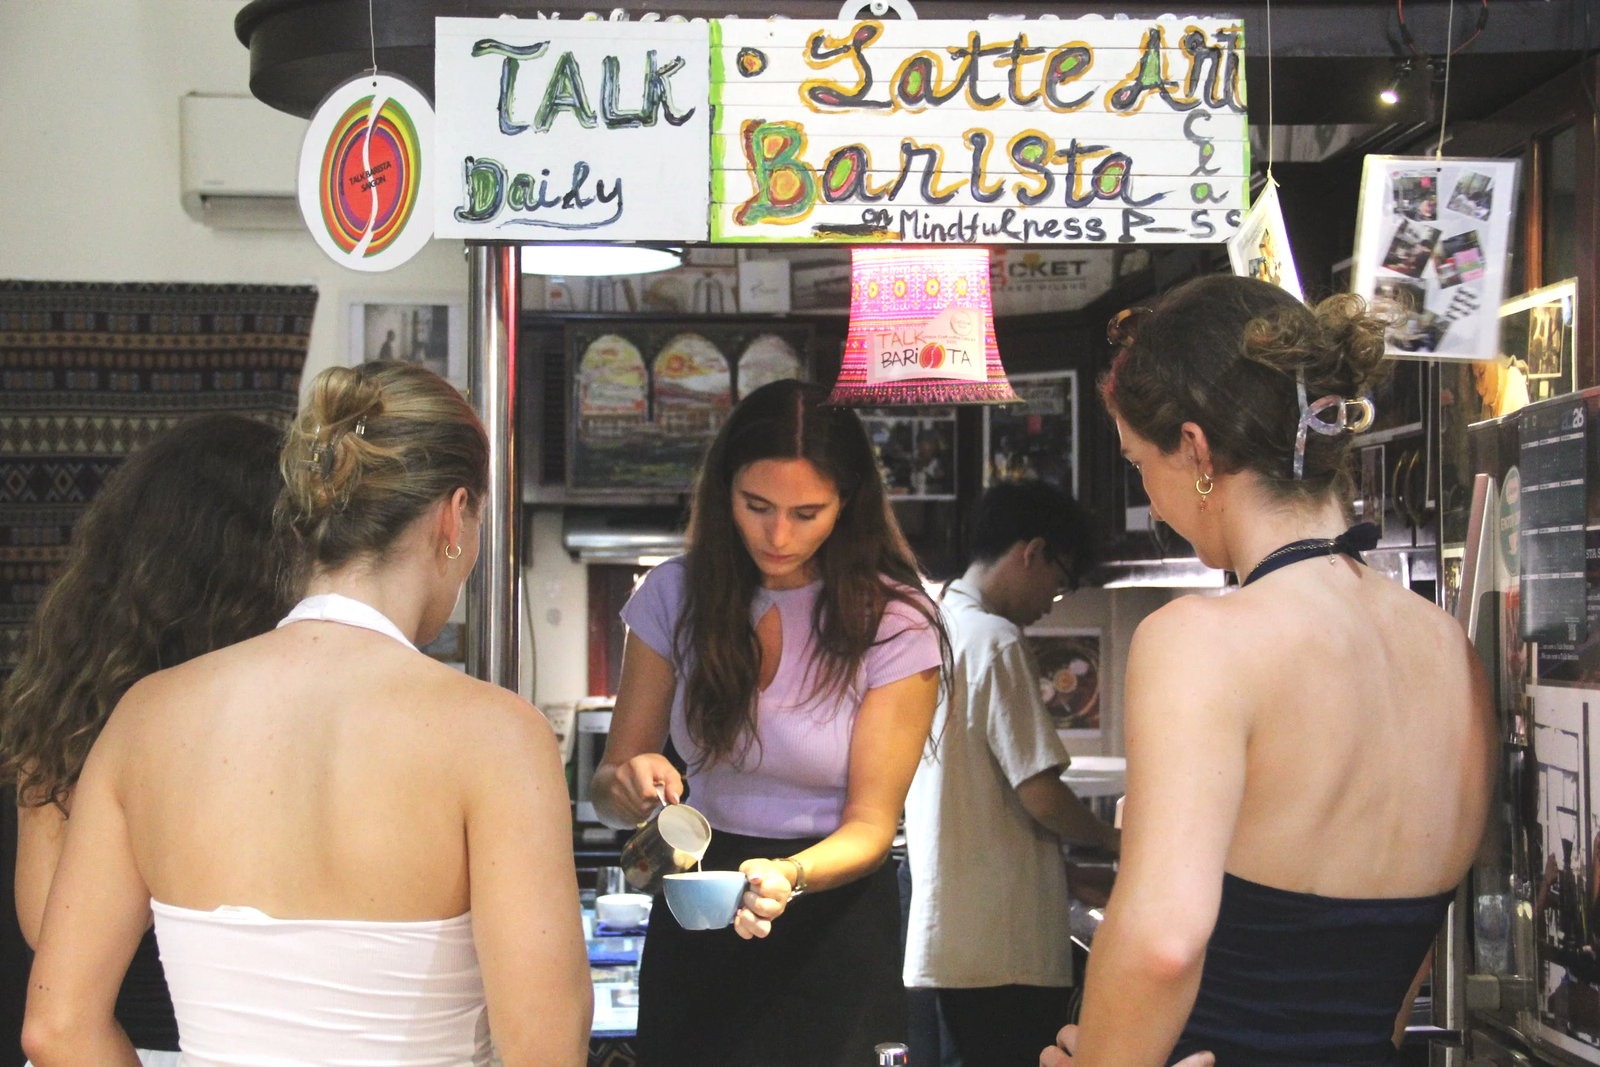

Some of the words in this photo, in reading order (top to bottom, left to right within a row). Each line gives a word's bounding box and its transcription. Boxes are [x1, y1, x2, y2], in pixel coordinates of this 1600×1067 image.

[798, 20, 1101, 115] Latte
[1104, 24, 1248, 117] Art
[471, 39, 697, 136] TALK
[349, 171, 366, 186] TALK
[366, 161, 392, 178] BARISTA
[361, 174, 387, 193] SAIGON
[732, 119, 1177, 226] Barista
[453, 155, 624, 230] Daily
[900, 207, 1108, 243] Mindfulness
[990, 259, 1088, 278] CKET
[876, 329, 928, 349] TALK
